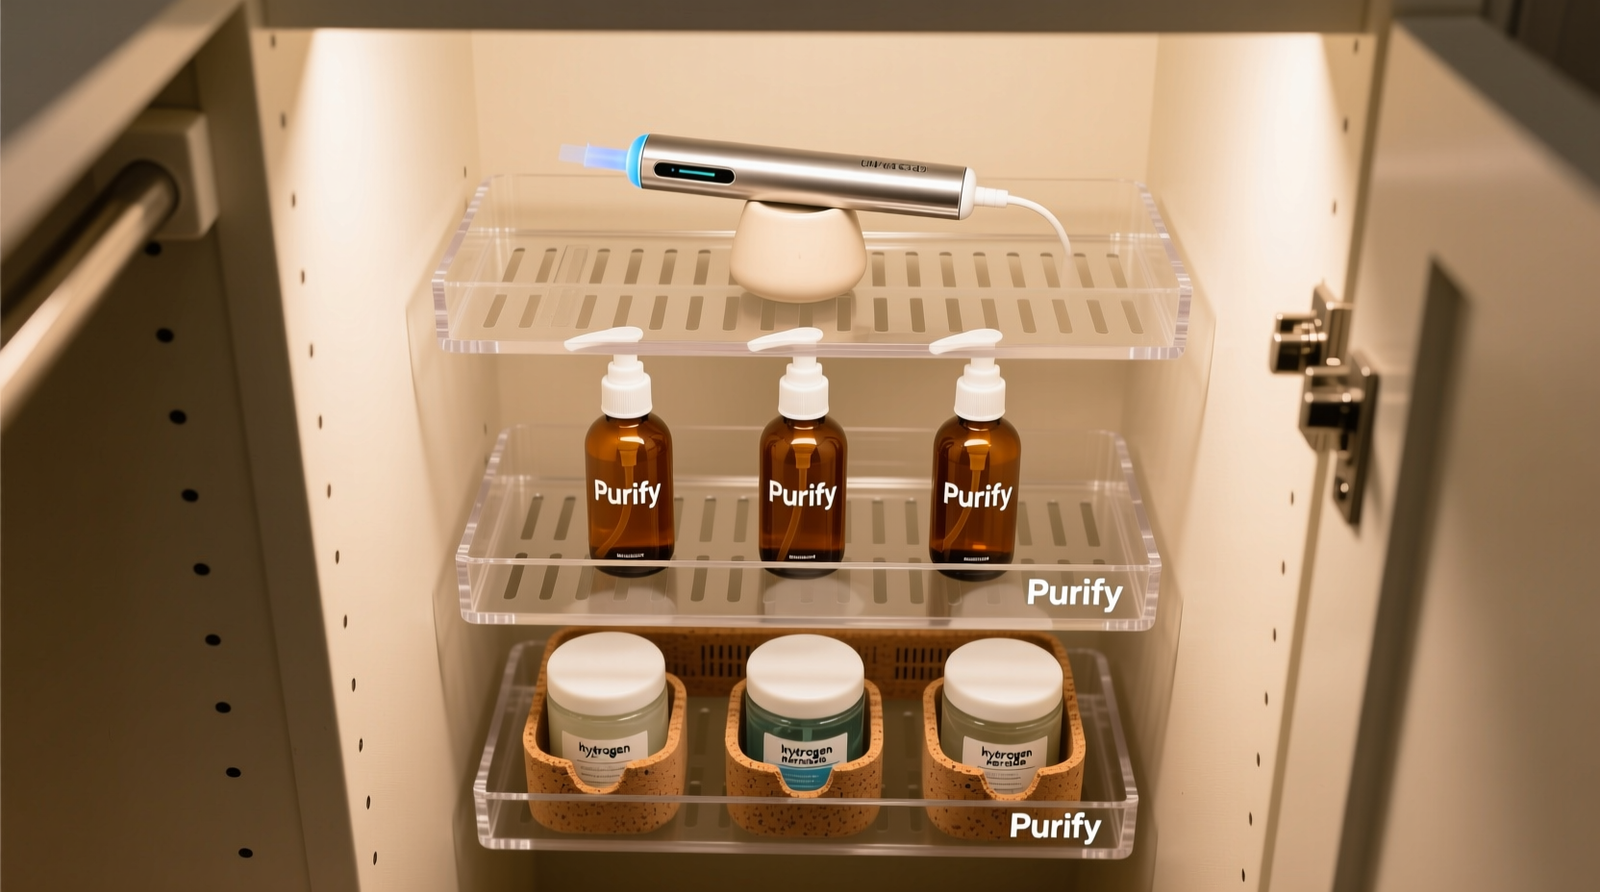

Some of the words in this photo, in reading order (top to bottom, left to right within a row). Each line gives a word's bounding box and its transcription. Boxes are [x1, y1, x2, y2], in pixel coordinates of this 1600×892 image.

[594, 479, 661, 509] Purify
[769, 480, 837, 511] Purify
[943, 482, 1013, 511] Purify
[1027, 578, 1124, 613] Purify
[1010, 812, 1102, 845] Purify
